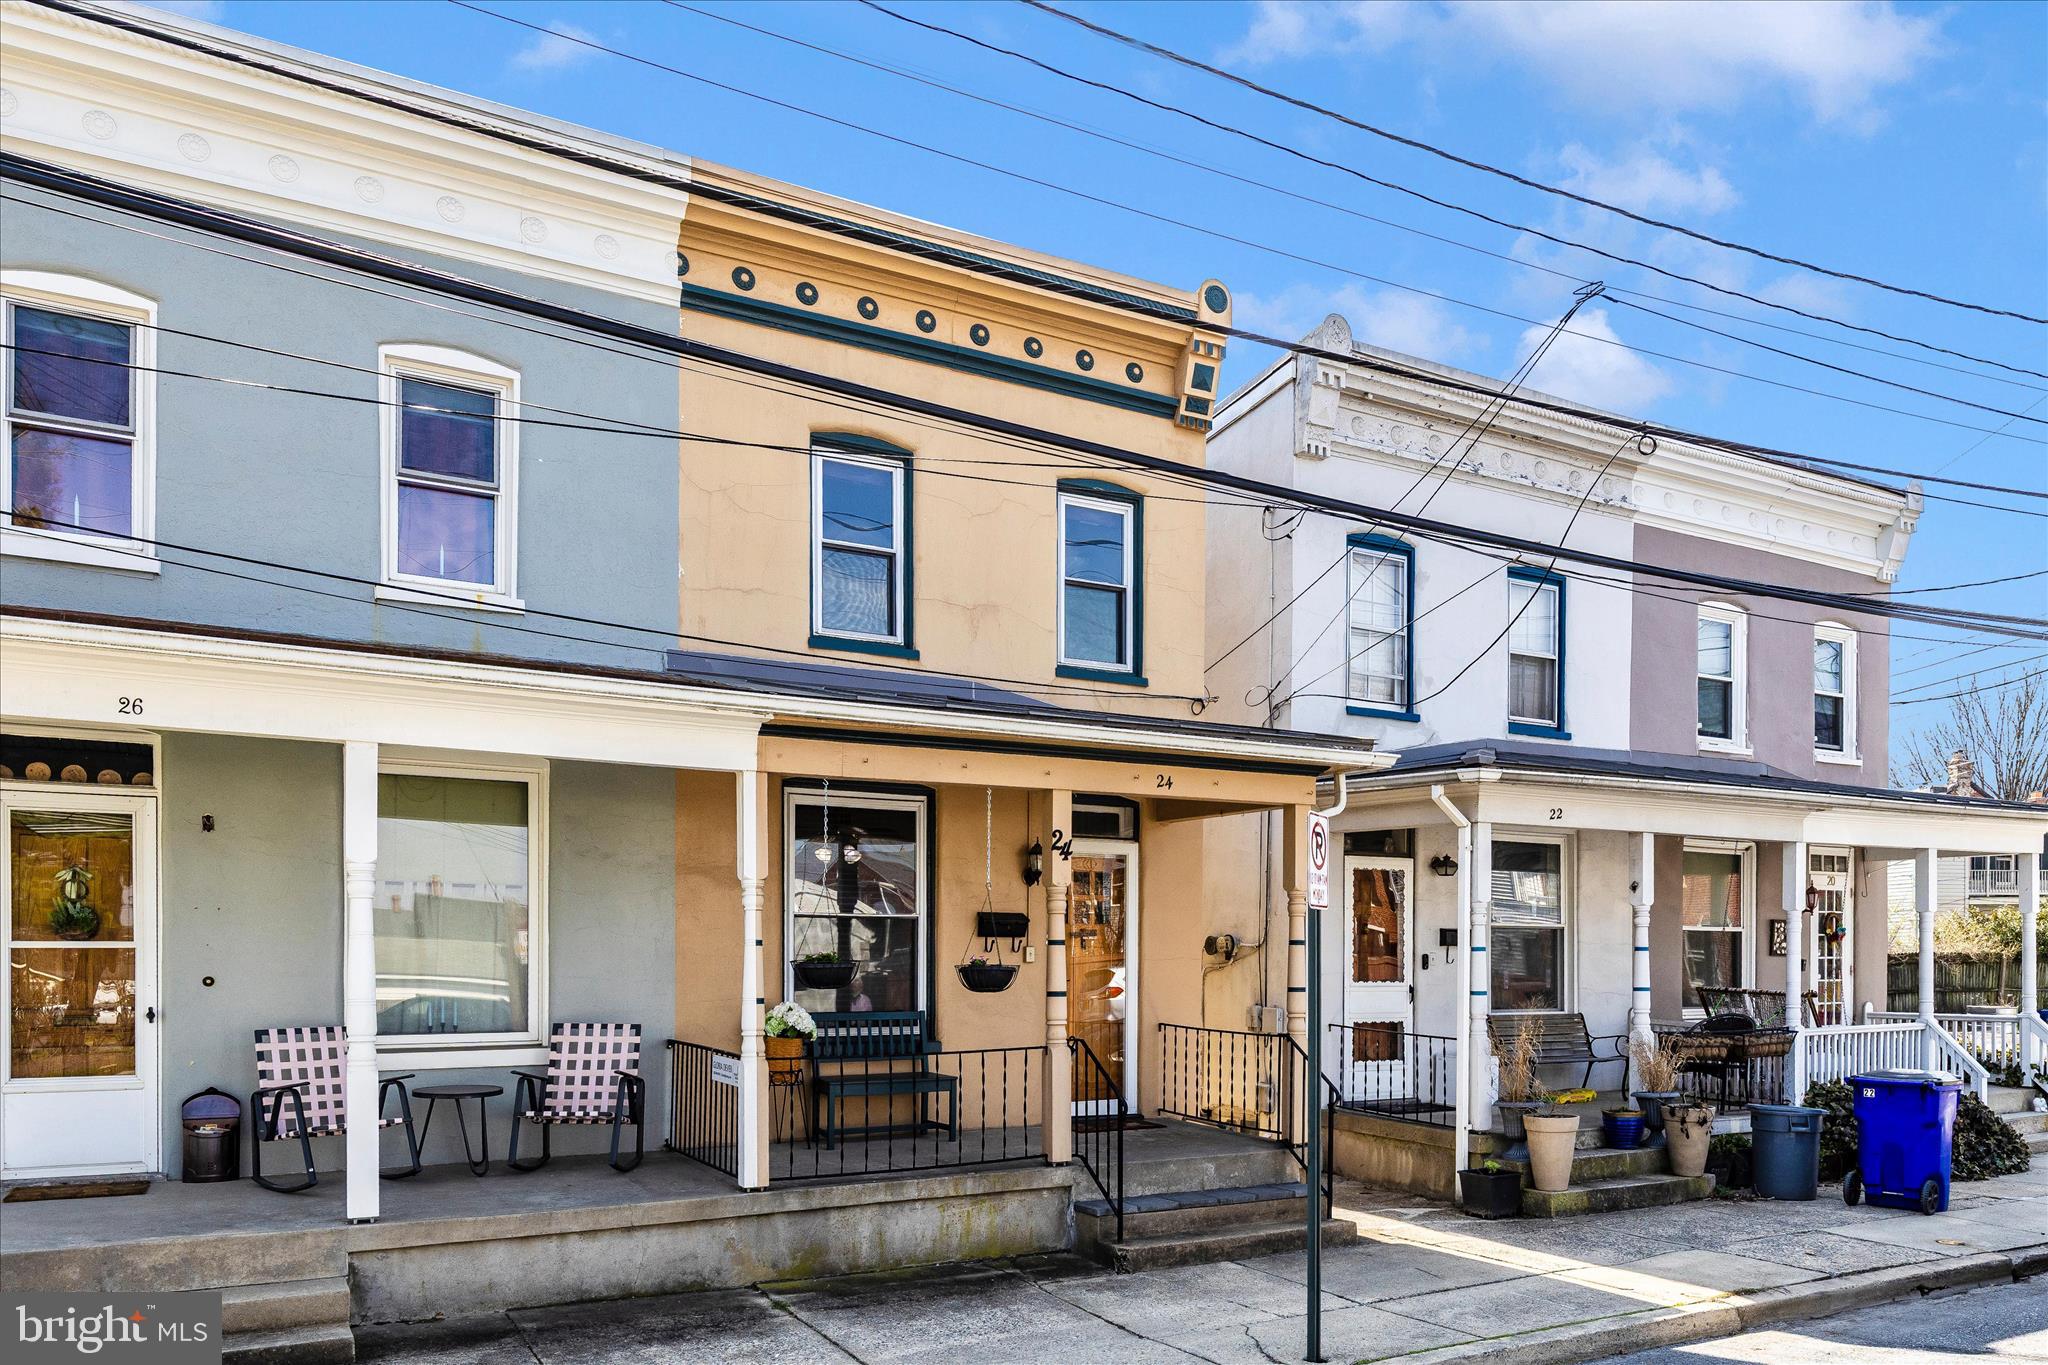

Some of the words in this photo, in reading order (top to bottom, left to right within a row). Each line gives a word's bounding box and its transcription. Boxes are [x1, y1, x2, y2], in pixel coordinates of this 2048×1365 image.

[118, 696, 143, 715] 26
[1156, 774, 1174, 790] 24
[1549, 807, 1563, 820] 22
[1051, 829, 1074, 861] 24
[1826, 875, 1836, 886] 20
[1864, 1088, 1875, 1097] 22
